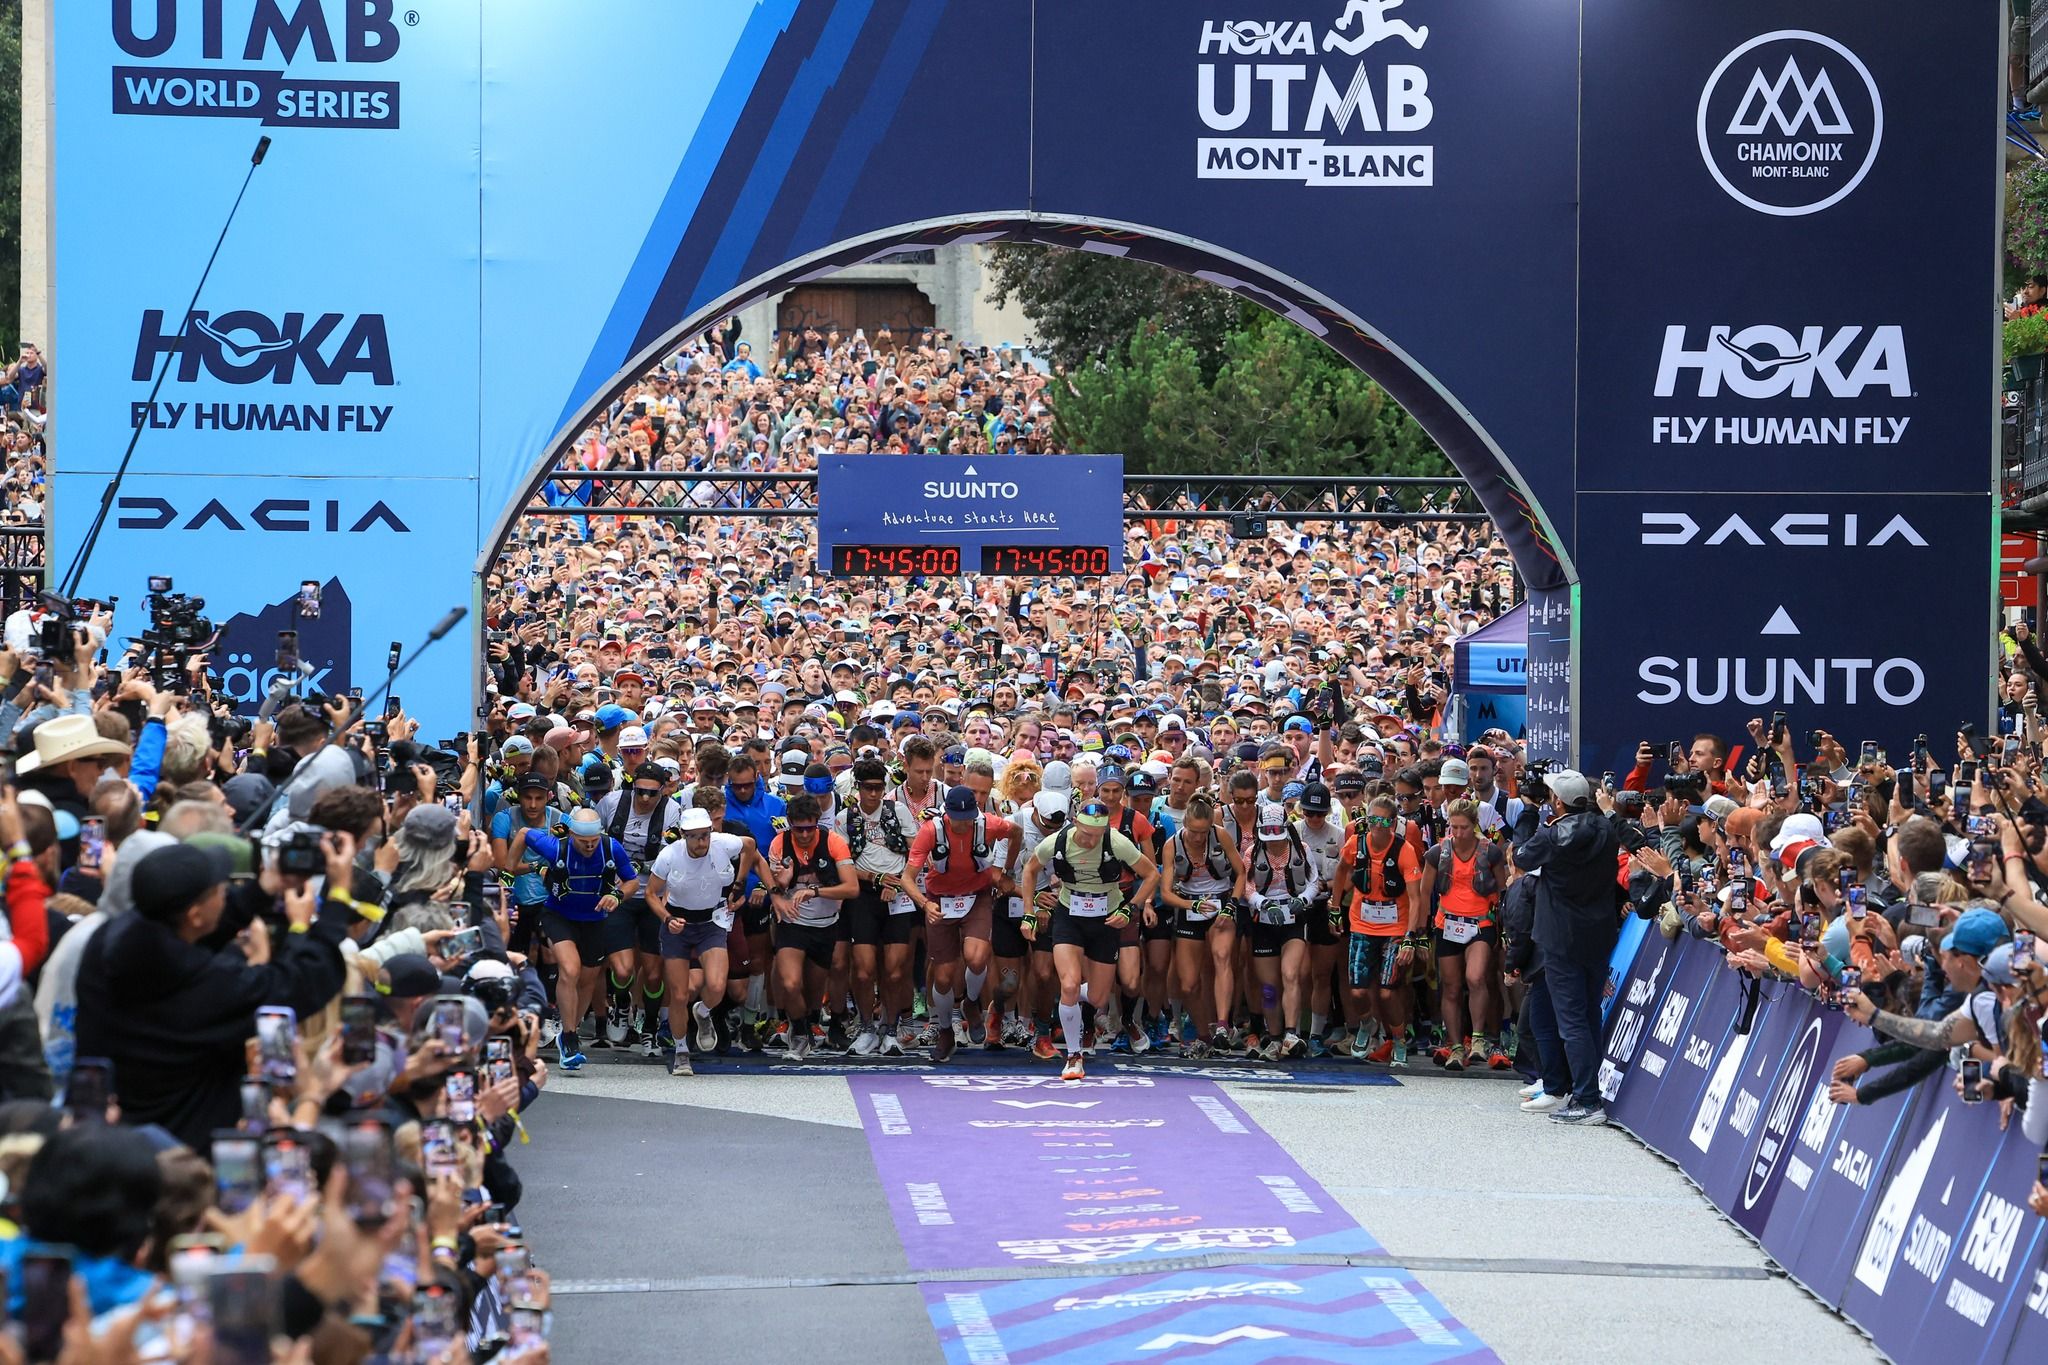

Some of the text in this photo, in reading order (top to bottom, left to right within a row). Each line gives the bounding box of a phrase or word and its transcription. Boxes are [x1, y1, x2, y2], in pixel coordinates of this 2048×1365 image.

[112, 0, 400, 66] UTMB
[1198, 20, 1316, 55] HOKA
[124, 77, 390, 119] WORLD SERIES
[1198, 59, 1434, 136] UTMB
[1737, 142, 1843, 161] CHAMONIX
[1752, 166, 1829, 178] MONT-BLANC
[131, 309, 394, 385] HOKA
[1653, 325, 1912, 399] HOKA
[130, 401, 394, 432] FLY HUMAN FLY
[1652, 416, 1911, 445] FLY HUMAN FLY
[923, 481, 1019, 499] SUUNTO
[118, 496, 411, 532] DACIA
[1641, 512, 1930, 546] DACIA
[844, 549, 959, 574] 17:45:00
[994, 549, 1108, 574] 17:45:00
[1636, 656, 1926, 705] SUUNTO
[1455, 926, 1464, 934] 62
[1684, 1034, 1715, 1071] DACIA
[1833, 1140, 1874, 1191] DACIA
[1903, 1213, 1952, 1284] SUUNTO
[1961, 1191, 2025, 1283] HOKA
